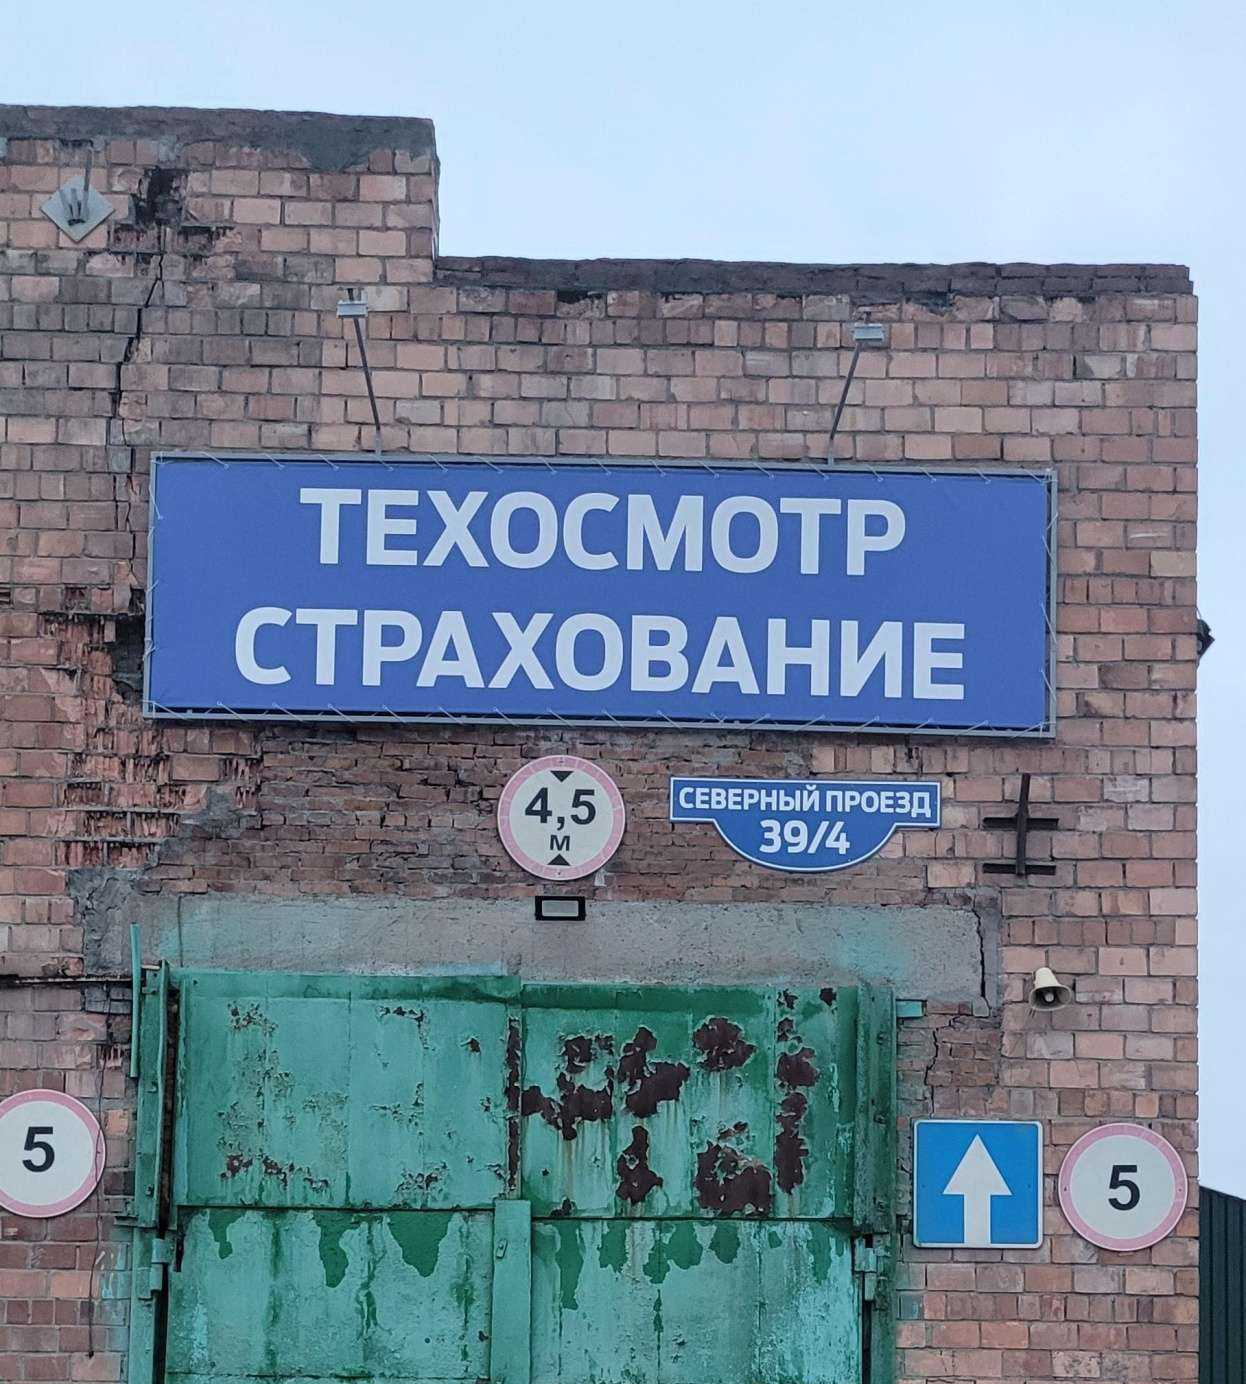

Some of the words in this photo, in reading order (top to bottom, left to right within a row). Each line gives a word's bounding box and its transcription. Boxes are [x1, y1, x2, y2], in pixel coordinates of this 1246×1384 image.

[299, 487, 906, 577] ТЕХОСМОТР
[234, 605, 966, 701] СТРАХОВАНИЕ
[524, 786, 597, 831] 4,5
[678, 784, 820, 813] СЕВЕРНЫЙ
[825, 789, 932, 818] ПРОЕЗД
[759, 818, 850, 855] 39/4
[22, 1126, 55, 1173] 5
[1108, 1164, 1141, 1211] 5
